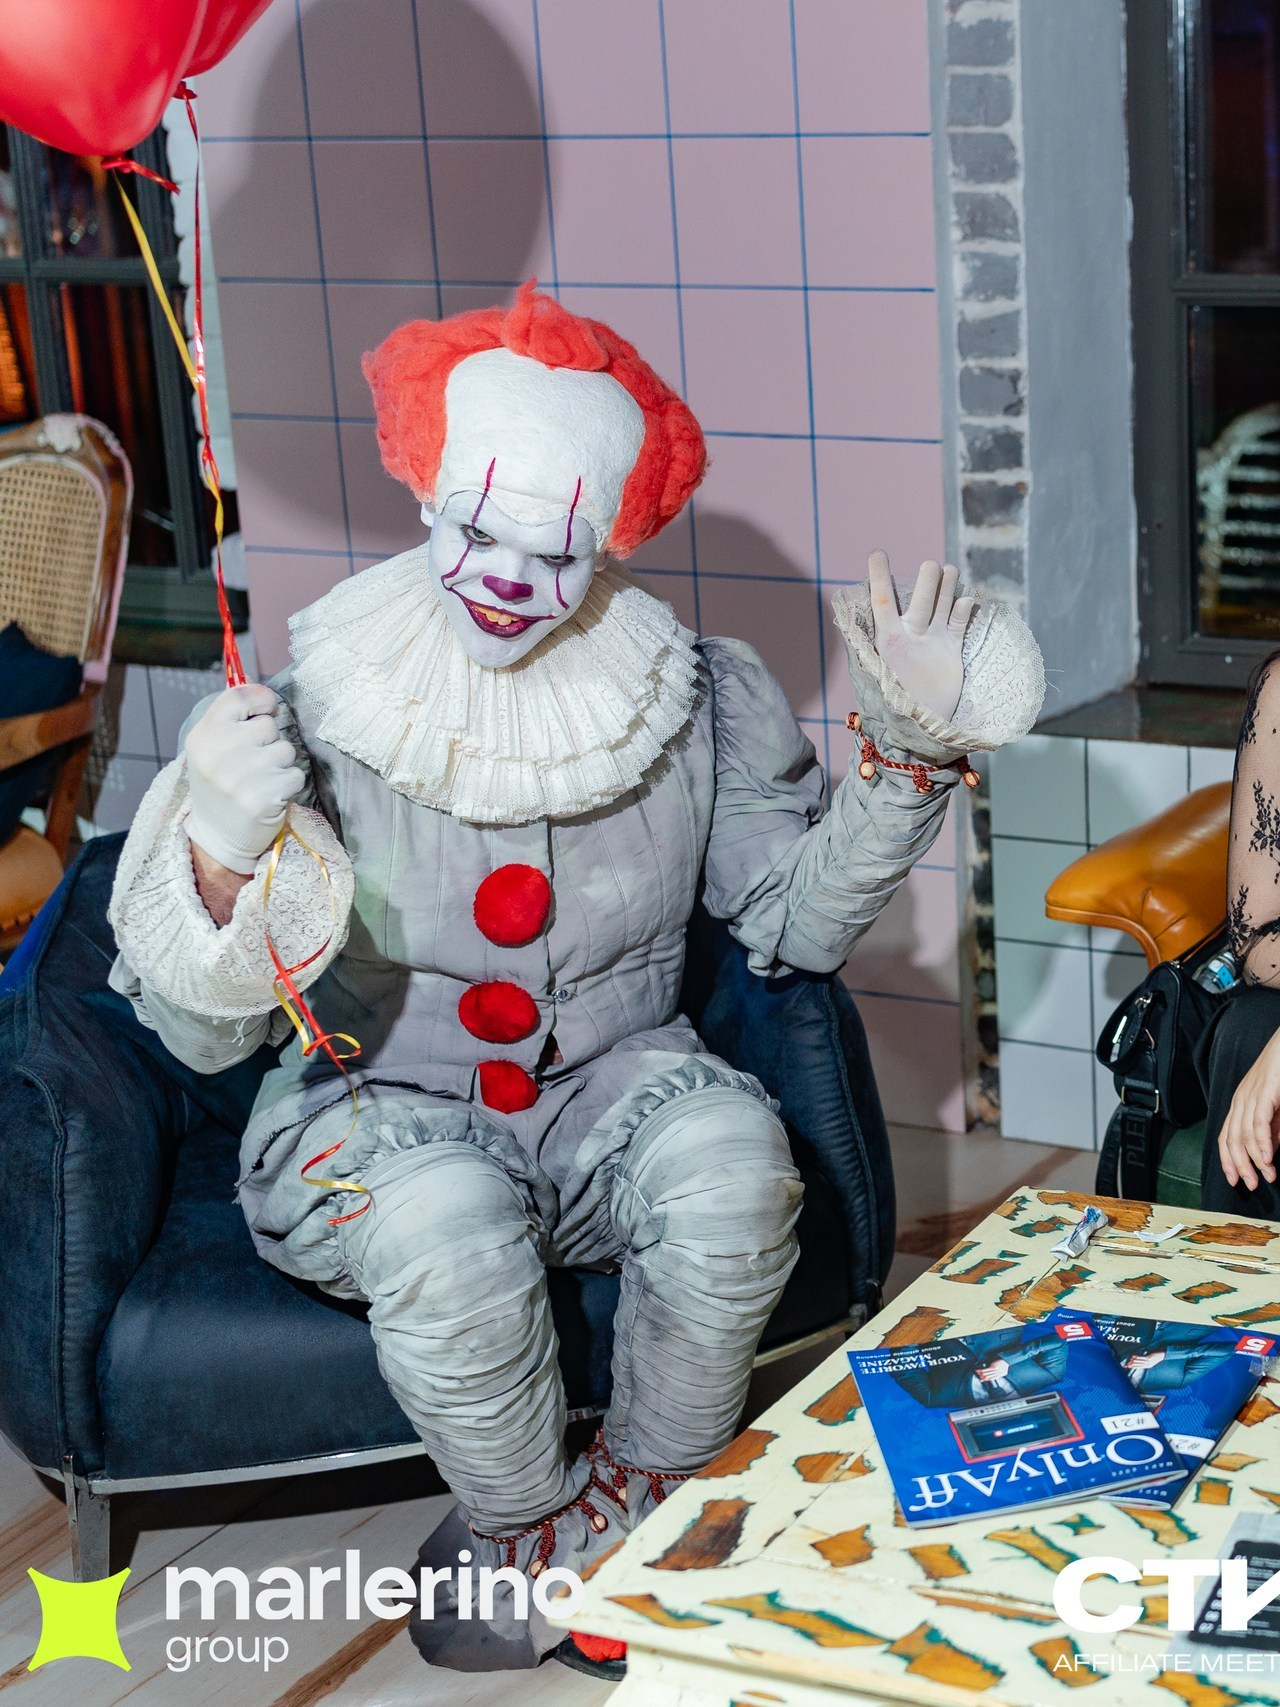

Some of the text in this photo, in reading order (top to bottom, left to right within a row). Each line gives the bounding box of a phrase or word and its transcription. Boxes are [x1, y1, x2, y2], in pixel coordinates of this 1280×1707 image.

[1063, 1324, 1085, 1336] 5
[1243, 1338, 1268, 1351] 5
[857, 1353, 932, 1368] MAGAZINE
[860, 1353, 967, 1375] YOUR FAVORITE
[1110, 1418, 1147, 1429] #21
[908, 1434, 1164, 1512] OnlyAff
